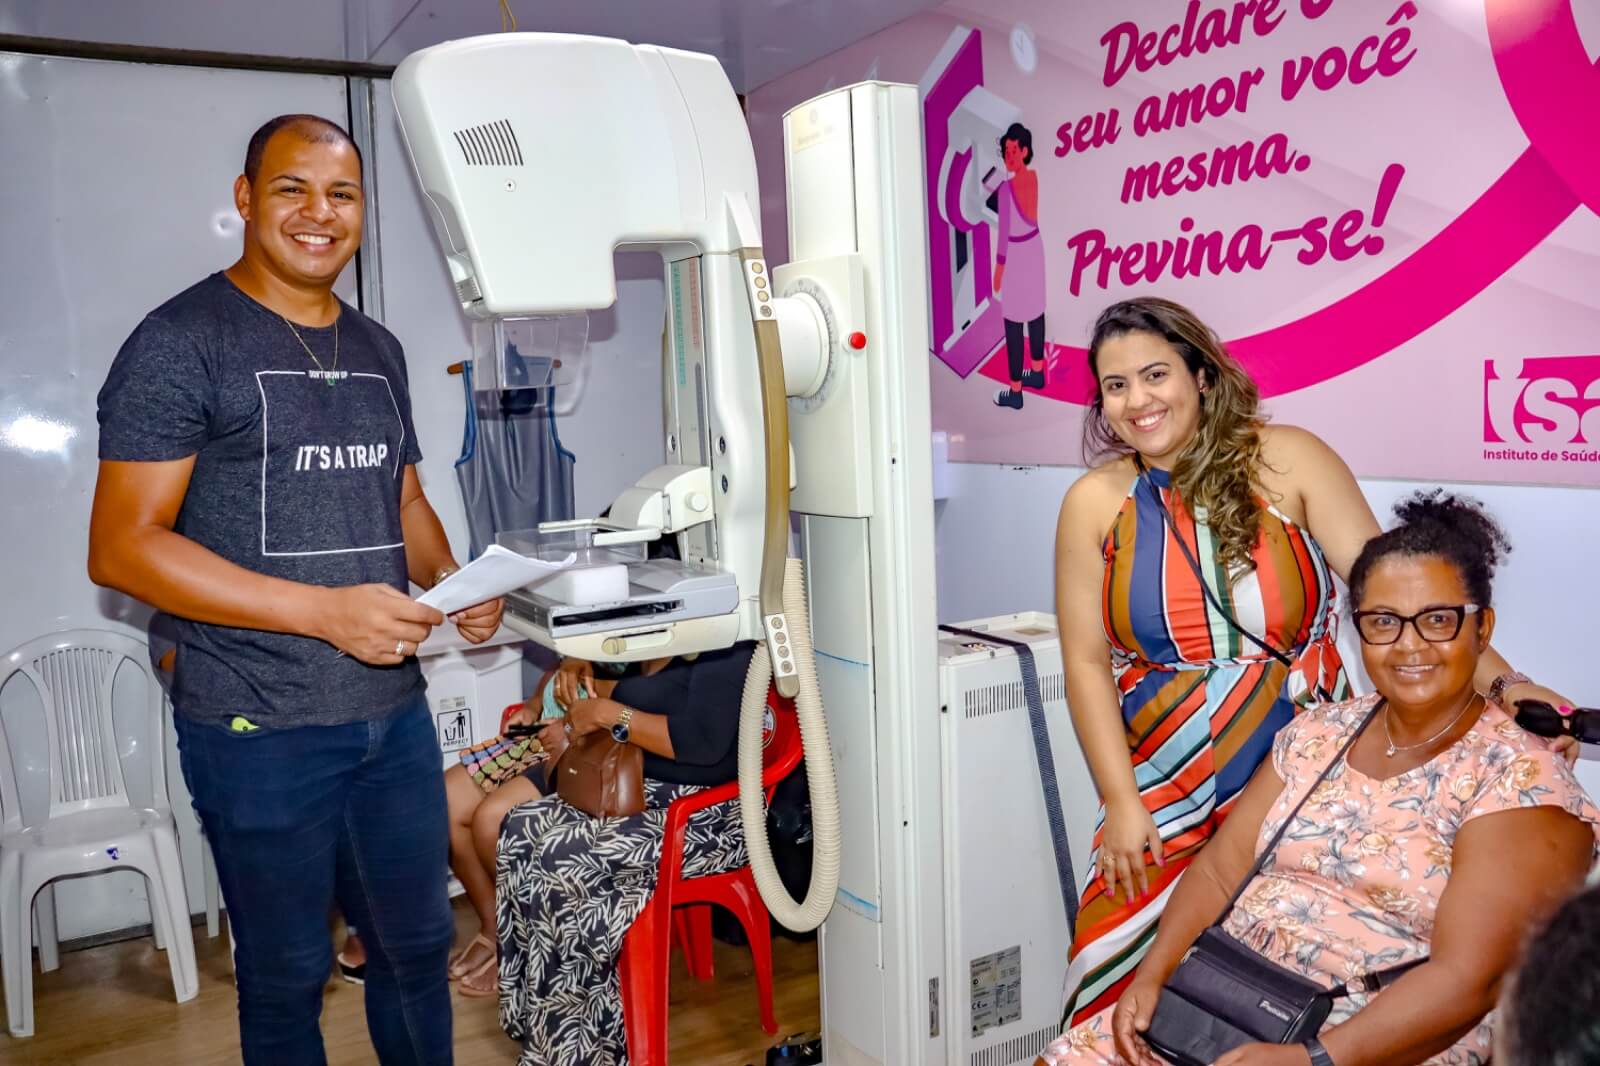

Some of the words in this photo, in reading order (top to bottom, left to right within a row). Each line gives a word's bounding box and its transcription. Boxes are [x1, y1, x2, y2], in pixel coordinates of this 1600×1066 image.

[1054, 108, 1121, 157] seu
[1133, 68, 1264, 137] amor
[1281, 0, 1418, 101] você
[1100, 0, 1286, 87] Declare
[1121, 133, 1311, 204] mesma.
[1067, 163, 1406, 297] Previna-se!
[296, 445, 331, 471] IT'S
[334, 445, 345, 470] A
[346, 443, 388, 469] TRAP
[1483, 448, 1538, 461] Instituto
[1541, 450, 1558, 461] de
[1561, 449, 1600, 462] Saúd
